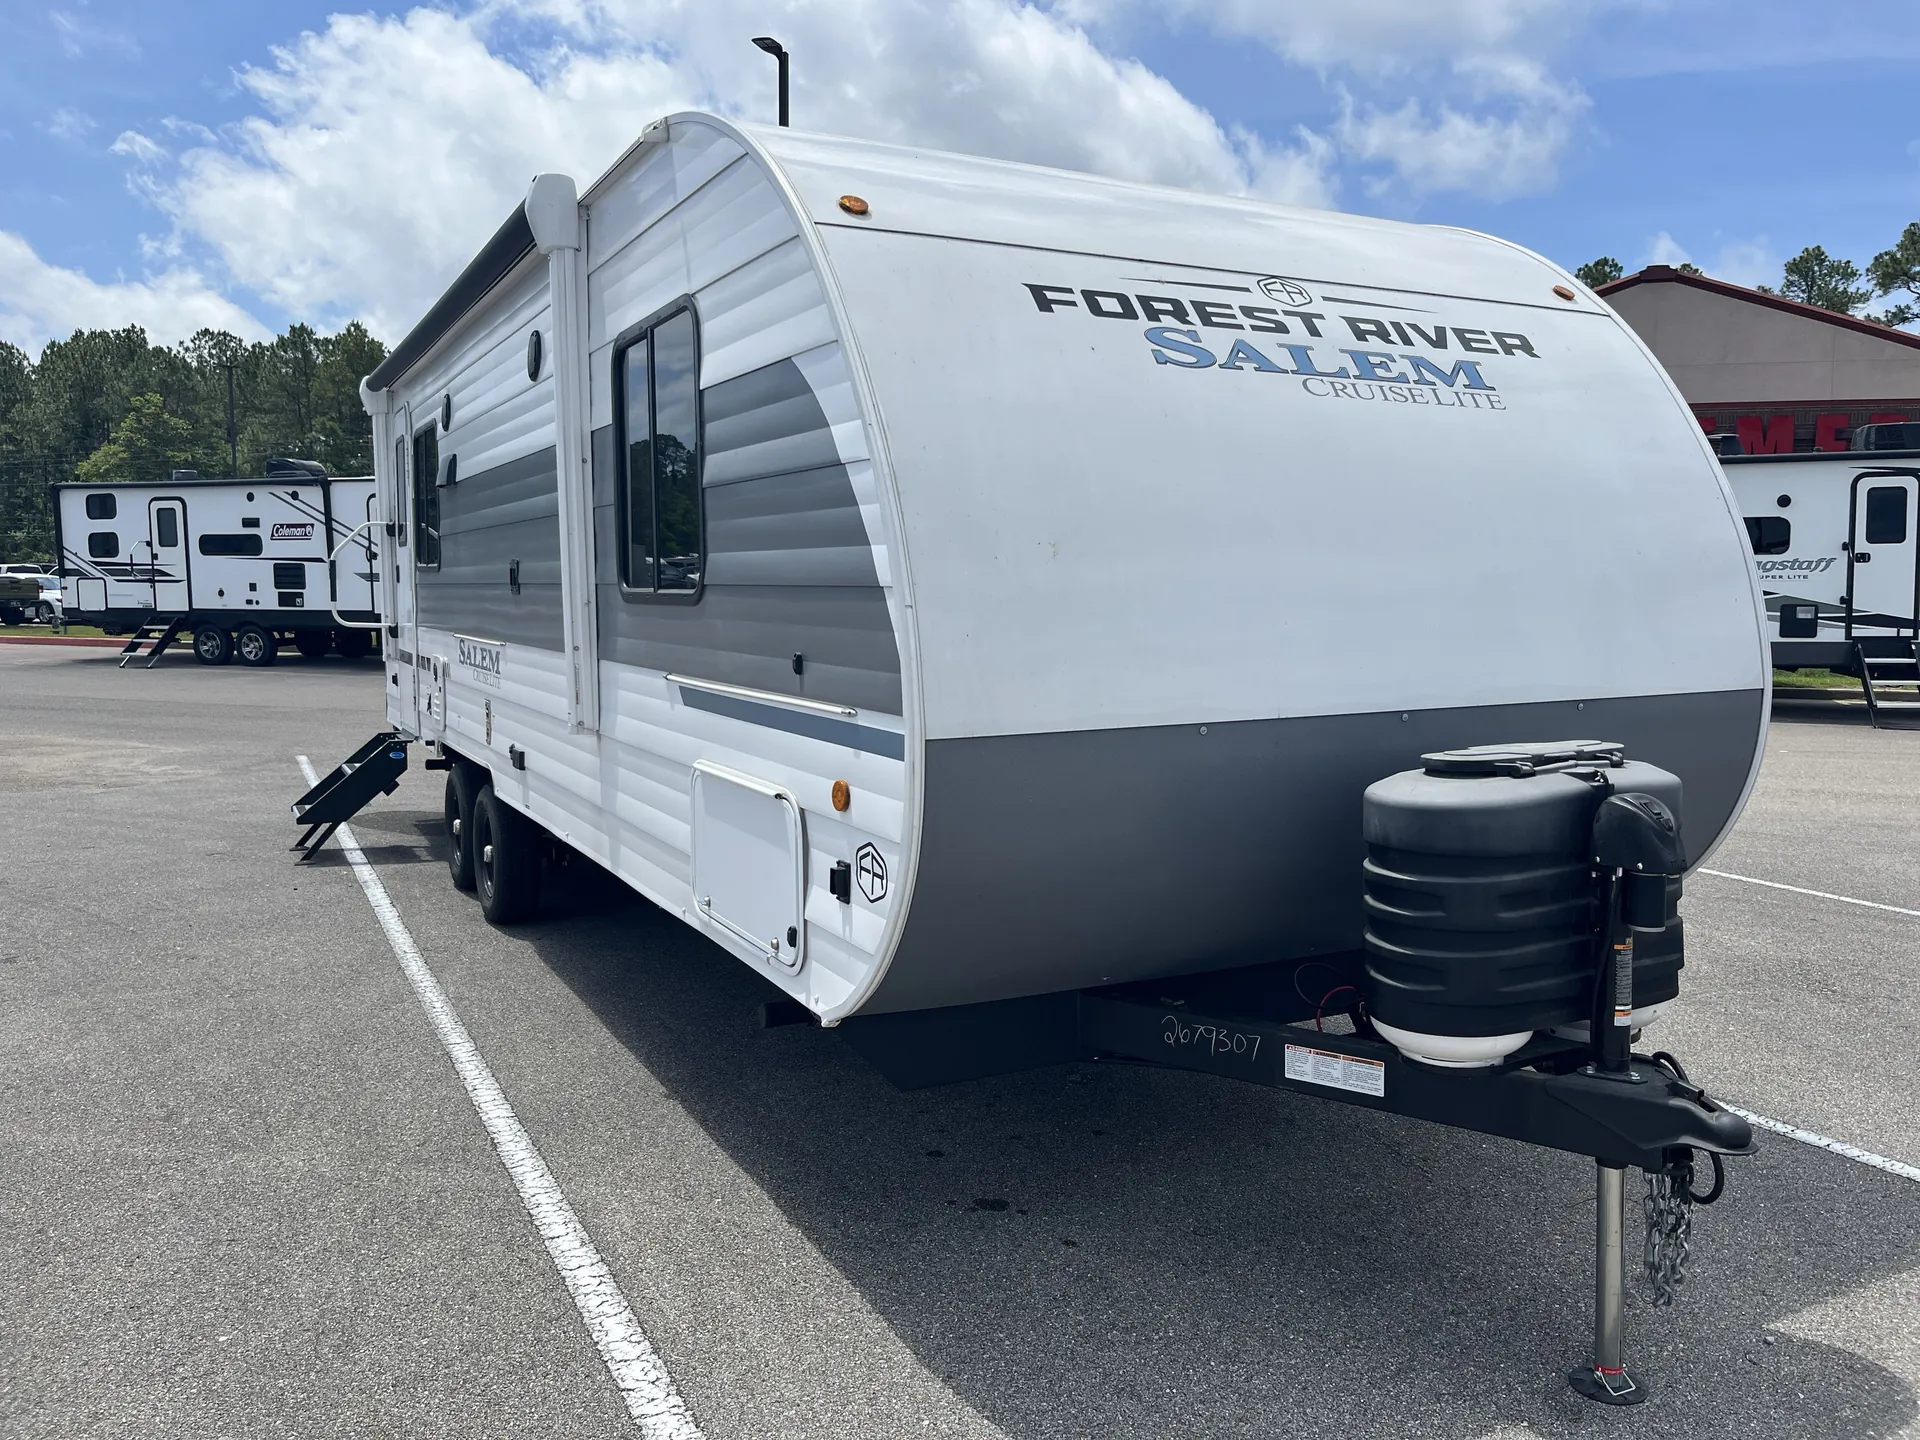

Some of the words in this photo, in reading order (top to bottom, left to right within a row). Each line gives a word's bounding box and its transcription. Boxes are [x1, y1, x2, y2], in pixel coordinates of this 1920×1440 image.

[1020, 282, 1326, 338] FOREST
[1338, 315, 1542, 359] RIVER
[1144, 326, 1497, 392] SALEM
[273, 524, 305, 536] Coleman
[458, 638, 501, 675] SALEM
[1160, 1015, 1261, 1062] 2679307
